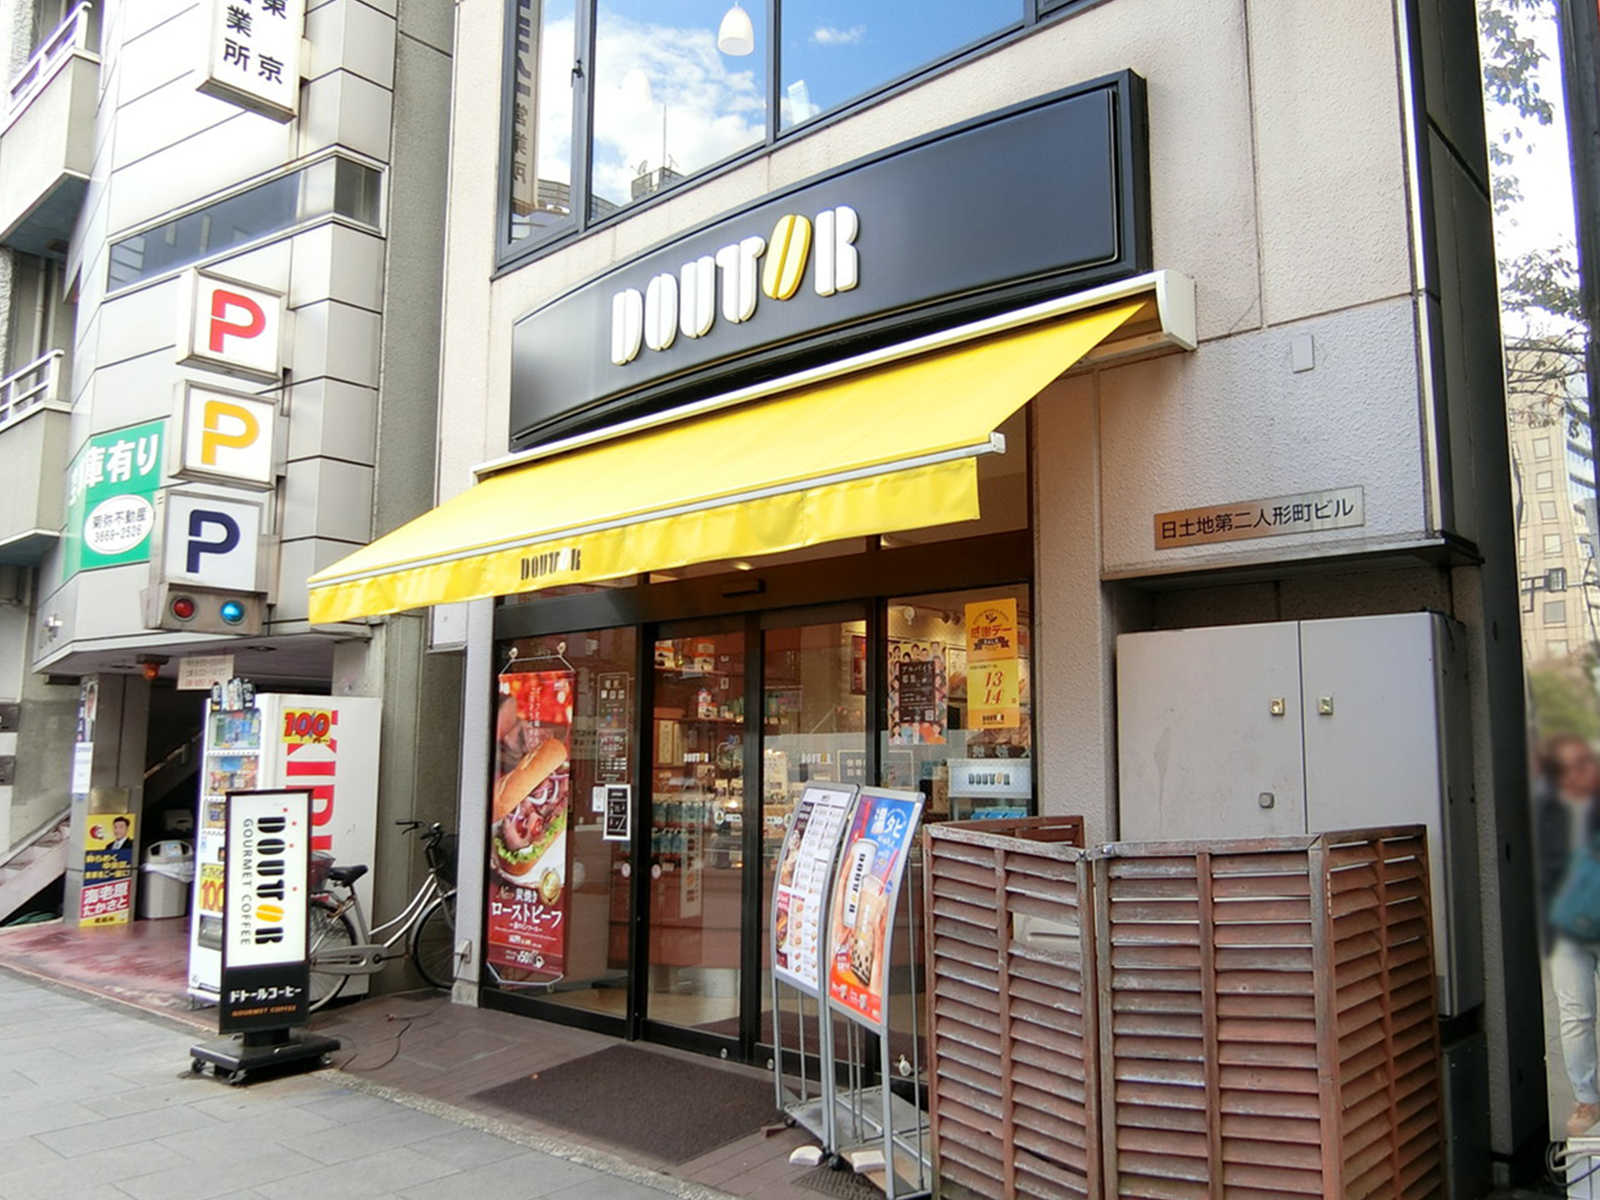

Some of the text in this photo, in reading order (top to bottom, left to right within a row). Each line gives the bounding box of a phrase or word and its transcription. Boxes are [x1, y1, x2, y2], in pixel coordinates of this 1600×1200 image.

[223, 0, 252, 71] 業所
[258, 0, 287, 84] 東京
[611, 205, 858, 366] DOUTOR
[209, 289, 266, 352] P
[201, 400, 260, 466] P
[186, 509, 241, 574] P
[1162, 498, 1354, 539] 日土地第二人形町ビル
[521, 546, 581, 581] DOUTOR
[984, 689, 1002, 705] 14
[985, 671, 1003, 687] 13
[284, 711, 330, 738] 100
[240, 818, 254, 945] GOURMET COFFEE
[255, 816, 286, 944] DOUTOR
[230, 985, 302, 1003] ドトールコーヒー
